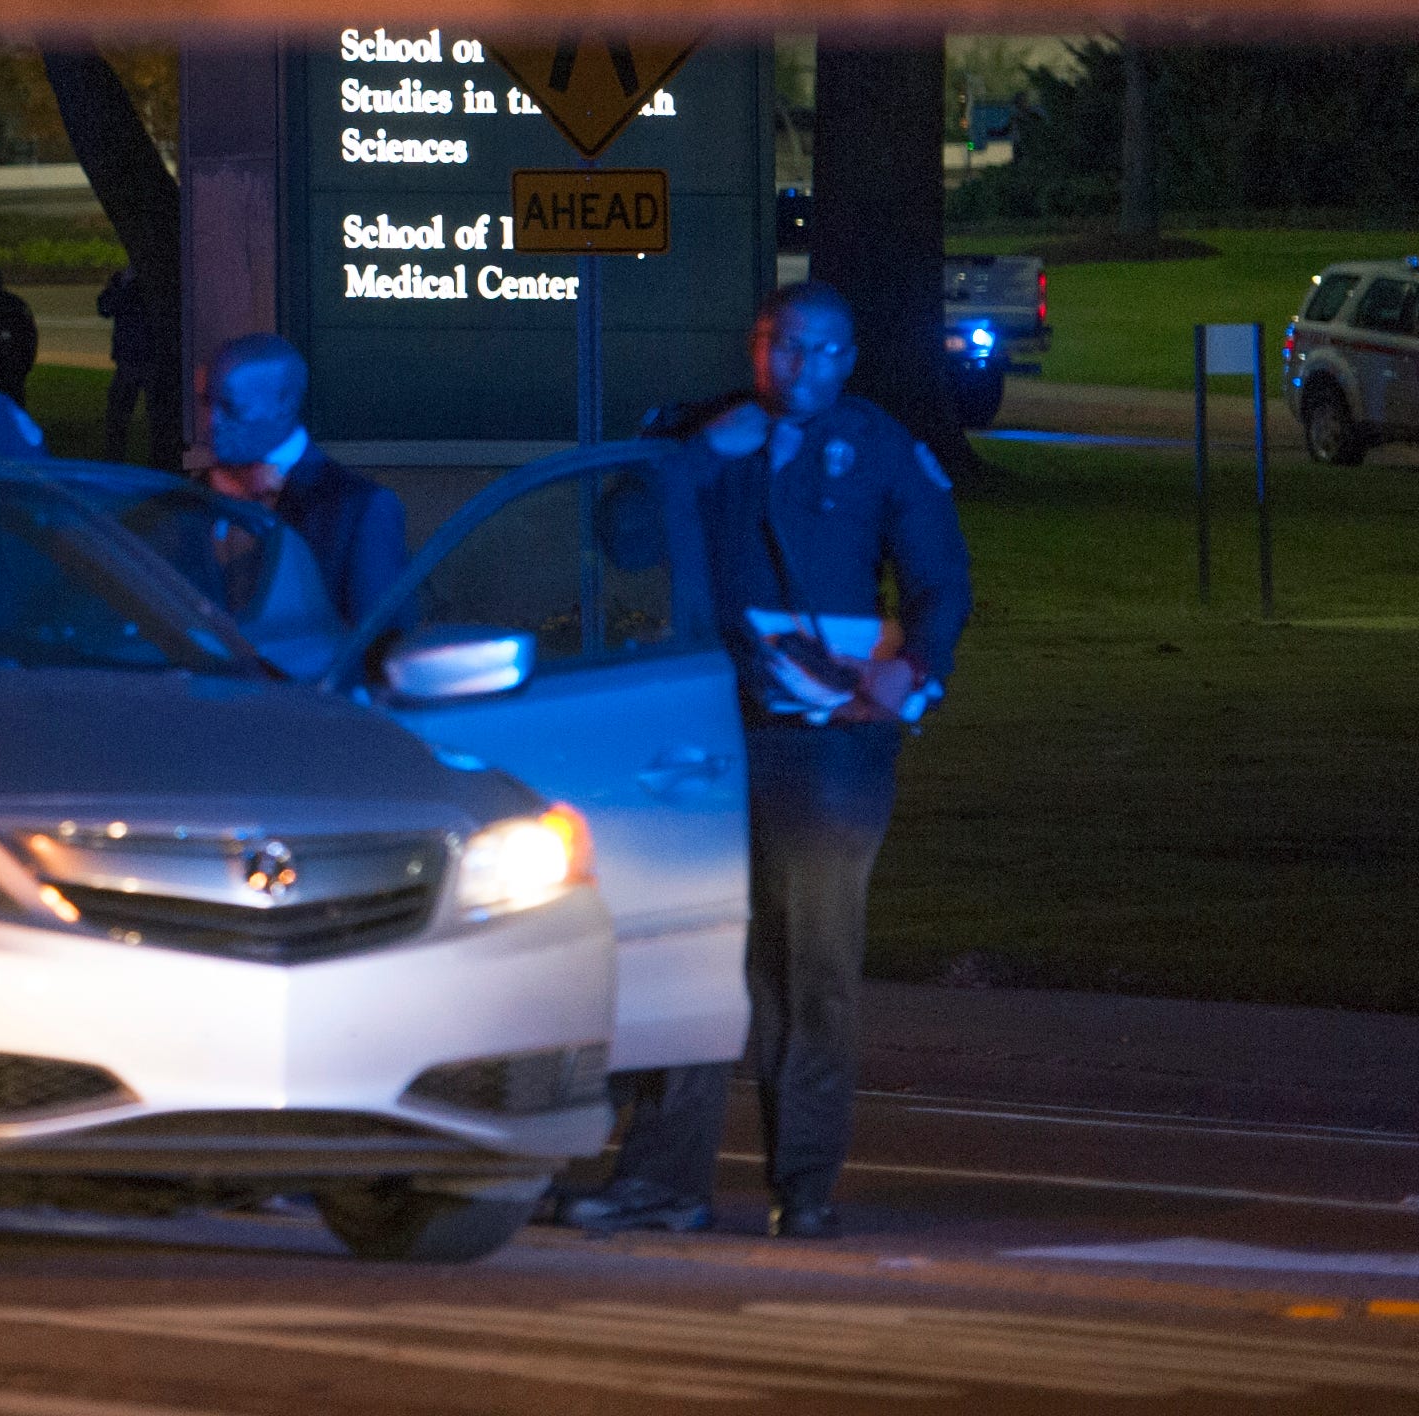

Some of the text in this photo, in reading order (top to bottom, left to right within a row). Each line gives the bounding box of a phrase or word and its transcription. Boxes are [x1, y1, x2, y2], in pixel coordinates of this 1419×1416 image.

[341, 28, 442, 63] School
[341, 78, 453, 114] Studies
[463, 80, 497, 113] in
[342, 128, 468, 163] Sciences
[522, 192, 660, 231] AHEAD
[344, 214, 445, 249] School
[455, 214, 490, 250] of
[344, 263, 579, 300] Medical Center
